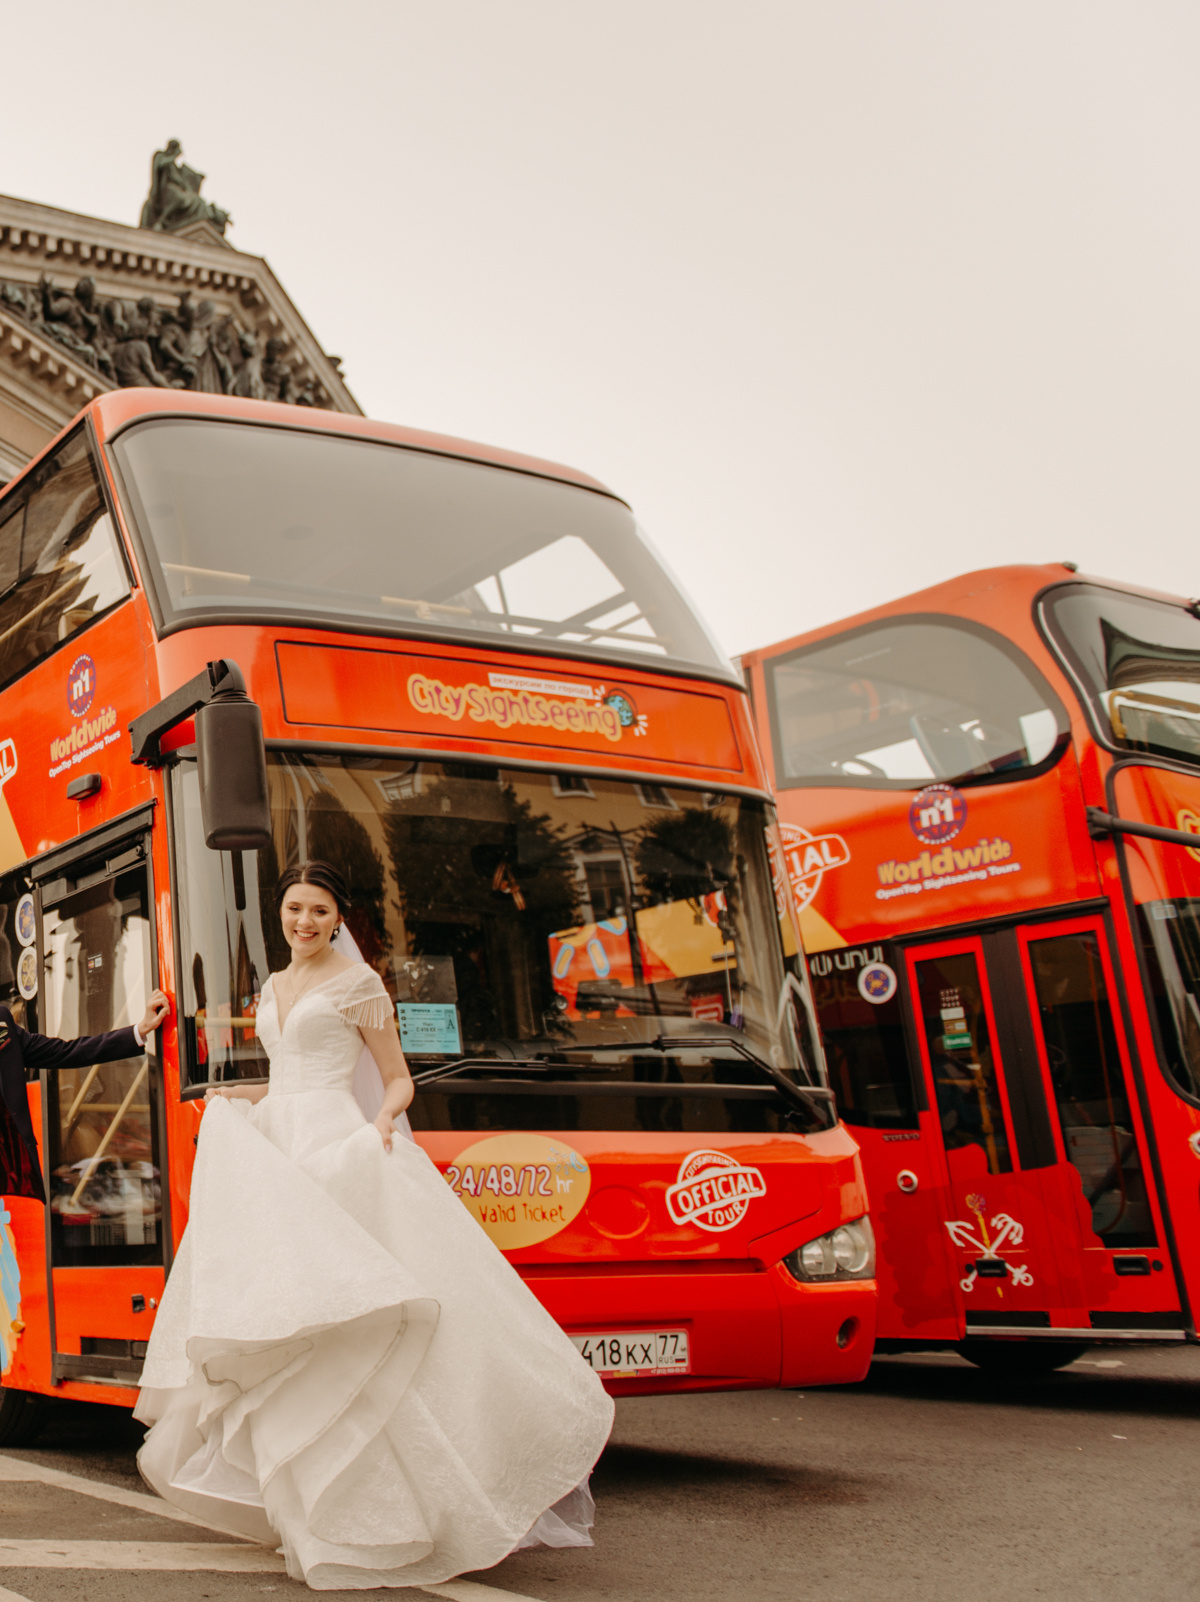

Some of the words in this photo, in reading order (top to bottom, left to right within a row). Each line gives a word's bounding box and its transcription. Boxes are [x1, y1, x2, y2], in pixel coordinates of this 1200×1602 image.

[50, 706, 117, 762] Worldwide
[49, 759, 72, 778] OpenTop
[72, 741, 104, 764] Sightseeing
[104, 730, 121, 745] Tours
[878, 838, 1012, 885] Worldwide
[875, 883, 922, 900] OpenTop
[923, 869, 988, 890] Sightseeing
[987, 862, 1021, 876] Tours
[446, 1165, 553, 1197] 24/48/72
[555, 1175, 574, 1194] hr
[677, 1173, 760, 1214] OFFICIAL
[479, 1204, 516, 1223] Valid
[522, 1203, 566, 1223] Ticket
[706, 1201, 743, 1225] TOUR
[581, 1339, 653, 1367] 418KX
[659, 1334, 679, 1356] 77
[658, 1356, 675, 1364] RUS
